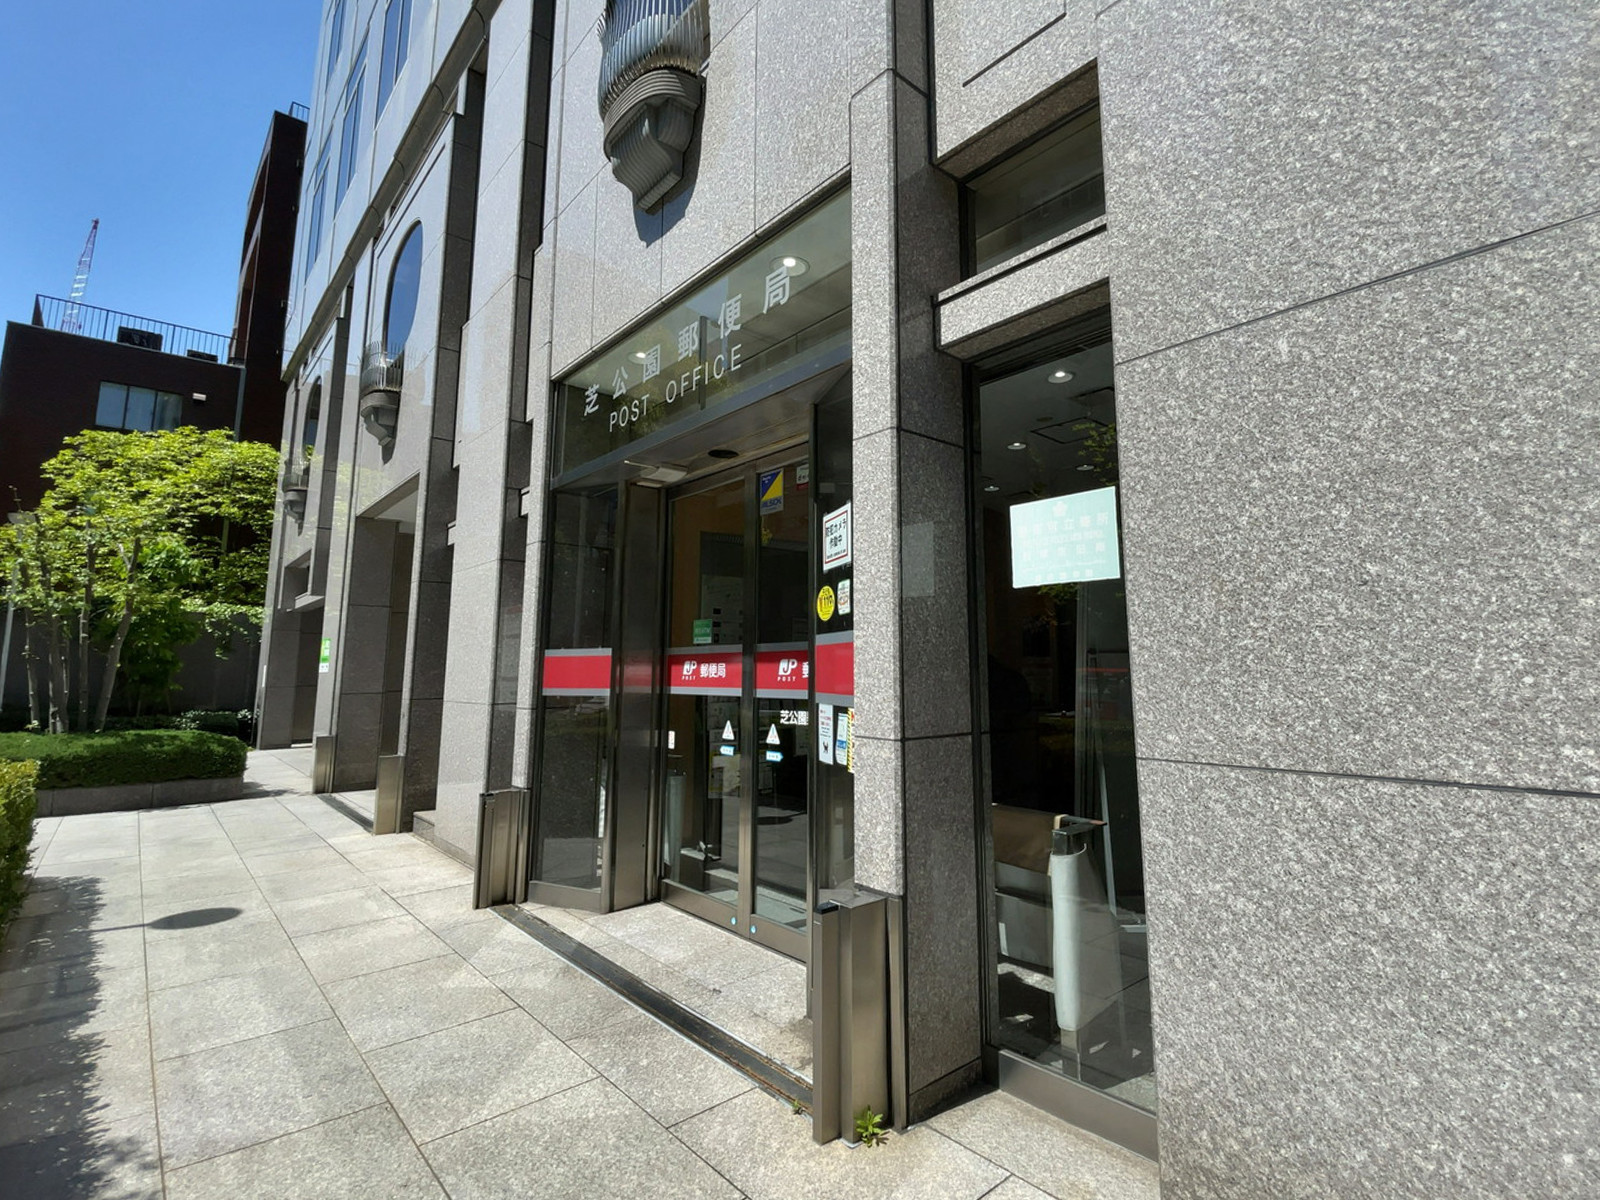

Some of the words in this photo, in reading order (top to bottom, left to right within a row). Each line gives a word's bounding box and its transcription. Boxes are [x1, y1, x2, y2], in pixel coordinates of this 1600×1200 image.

[583, 265, 791, 418] 芝公園郵便局
[609, 394, 650, 433] POST
[665, 343, 743, 405] OFFICE
[700, 662, 726, 679] 郵便局
